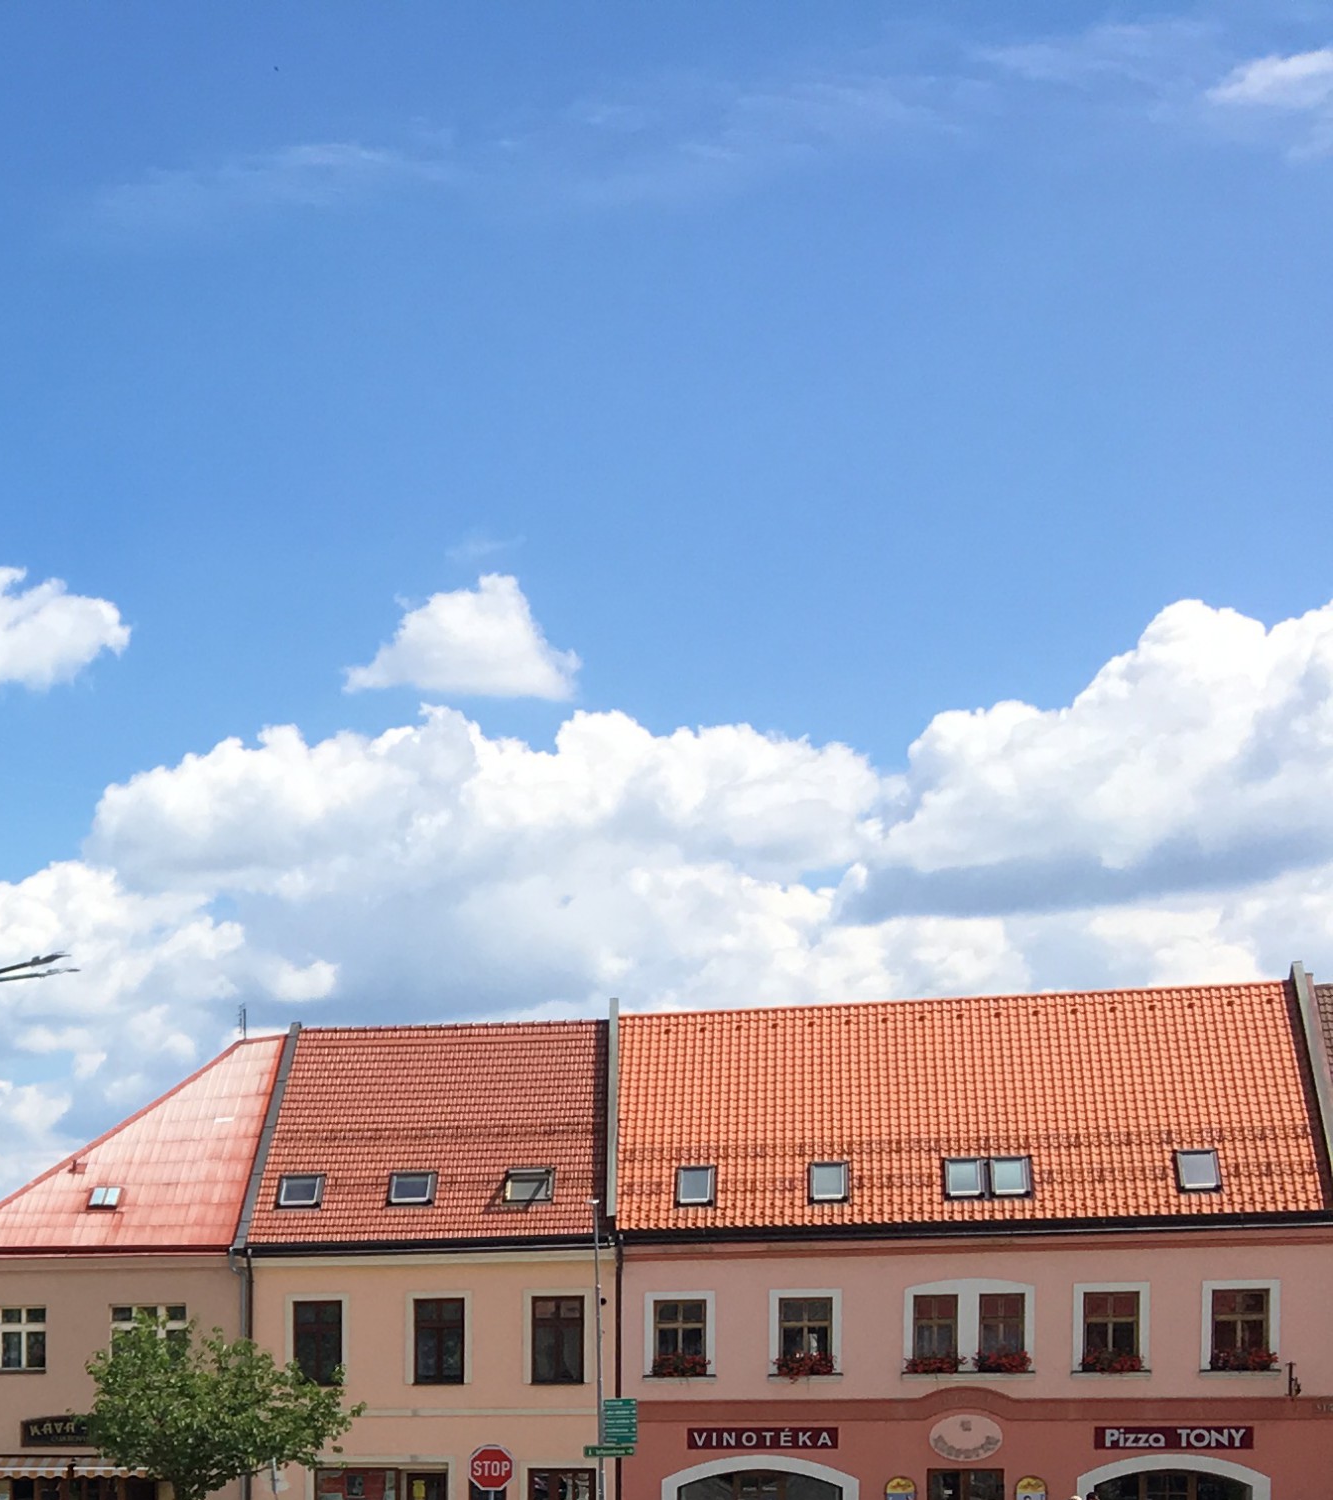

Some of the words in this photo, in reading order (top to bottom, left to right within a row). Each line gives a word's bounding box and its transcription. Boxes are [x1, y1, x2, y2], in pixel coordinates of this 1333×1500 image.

[693, 1428, 832, 1447] VINOTÉKA
[1105, 1428, 1165, 1448] Pizza
[1177, 1428, 1246, 1448] TONY
[473, 1461, 511, 1477] STOP
